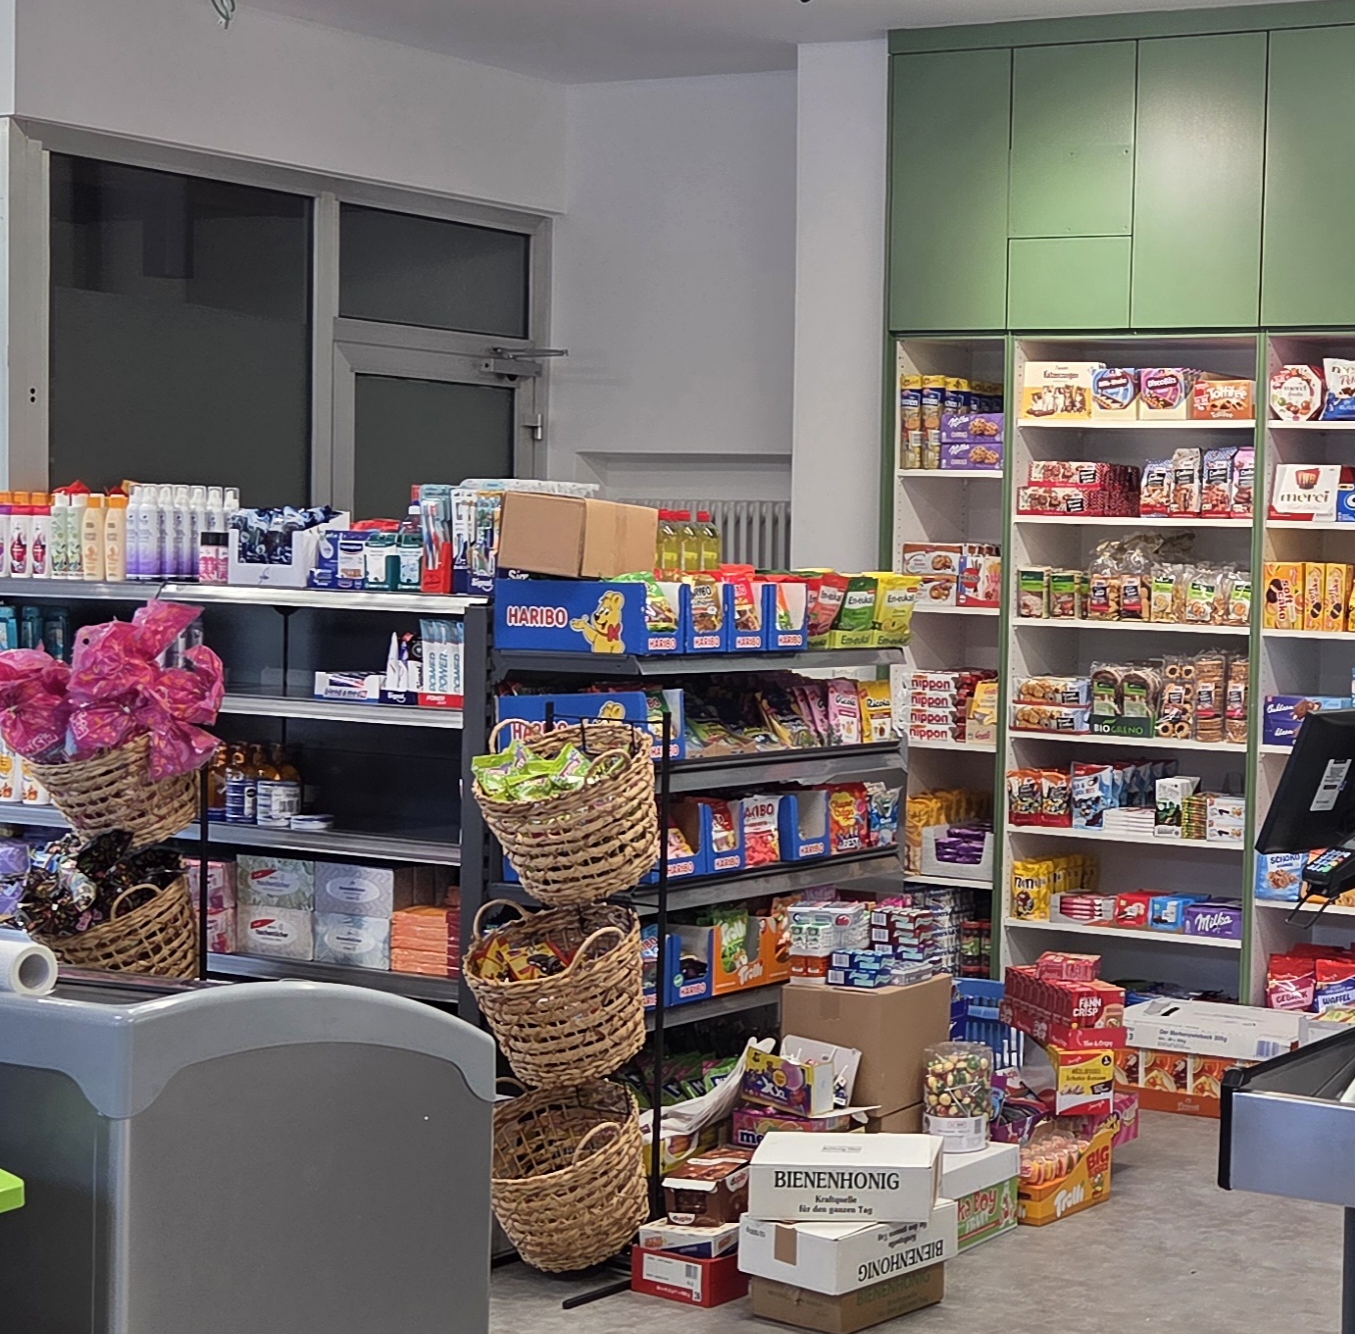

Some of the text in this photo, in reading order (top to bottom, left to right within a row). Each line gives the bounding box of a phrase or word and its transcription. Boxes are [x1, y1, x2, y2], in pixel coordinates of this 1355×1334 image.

[1280, 490, 1330, 503] merci
[507, 606, 568, 628] HARIBO
[649, 637, 677, 650] HARIBO
[694, 636, 721, 649] HARIBO
[736, 636, 762, 649] HARIBO
[778, 634, 802, 647] HARIBO
[911, 678, 951, 691] nippon
[911, 695, 949, 707] nippon
[910, 712, 948, 724] nippon
[909, 728, 948, 740] nippon
[714, 855, 740, 869] HARIBO
[1194, 912, 1233, 932] Milka
[679, 982, 706, 998] HARIBO
[1322, 994, 1351, 1005] WAFFEL
[1072, 1007, 1099, 1017] CRISP
[1086, 1145, 1109, 1168] BIG
[774, 1170, 900, 1190] BIENENHONIG
[815, 1195, 857, 1205] Kraftquelle
[974, 1186, 997, 1216] Boy
[1054, 1183, 1086, 1218] Trolli
[799, 1205, 873, 1216] für den ganzen Tag
[858, 1239, 944, 1282] BIENENHONIG
[856, 1271, 931, 1307] BIENENHONIG
